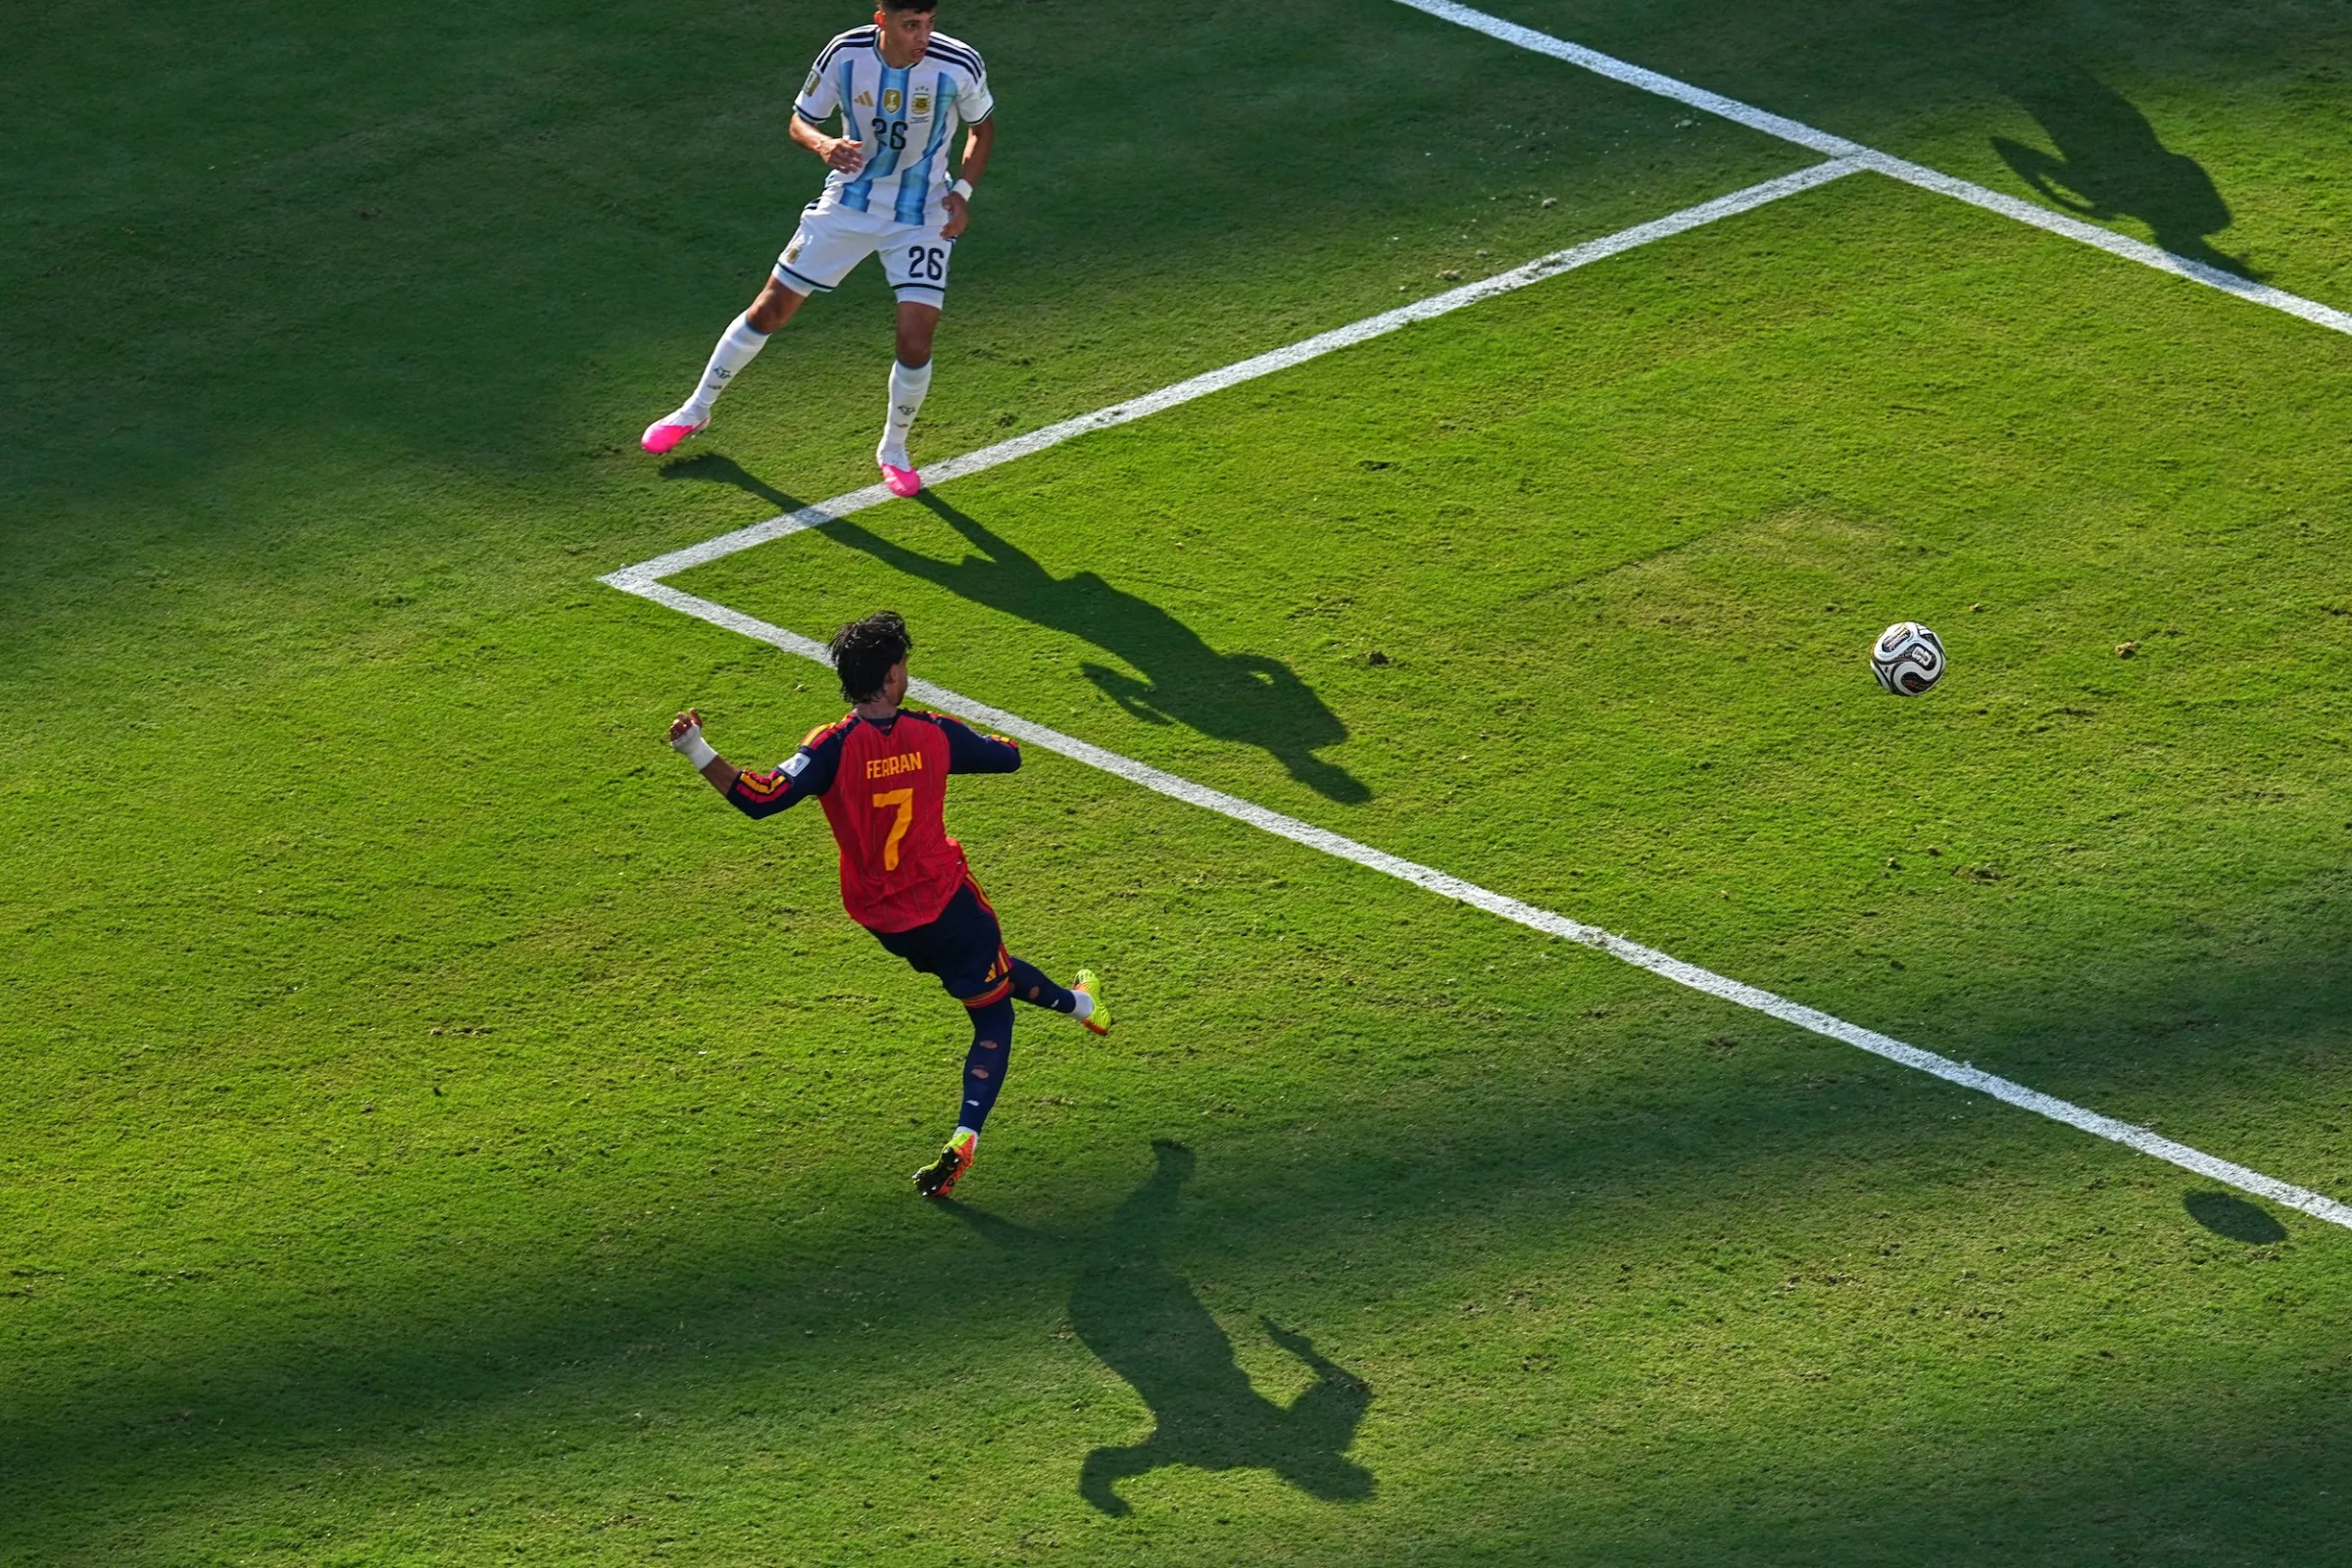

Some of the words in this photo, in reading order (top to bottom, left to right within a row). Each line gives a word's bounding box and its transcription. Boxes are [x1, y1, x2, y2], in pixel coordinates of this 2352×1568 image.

[871, 118, 908, 151] 26
[908, 243, 945, 281] 26
[866, 751, 923, 780] FERRAN
[872, 788, 913, 871] 7
